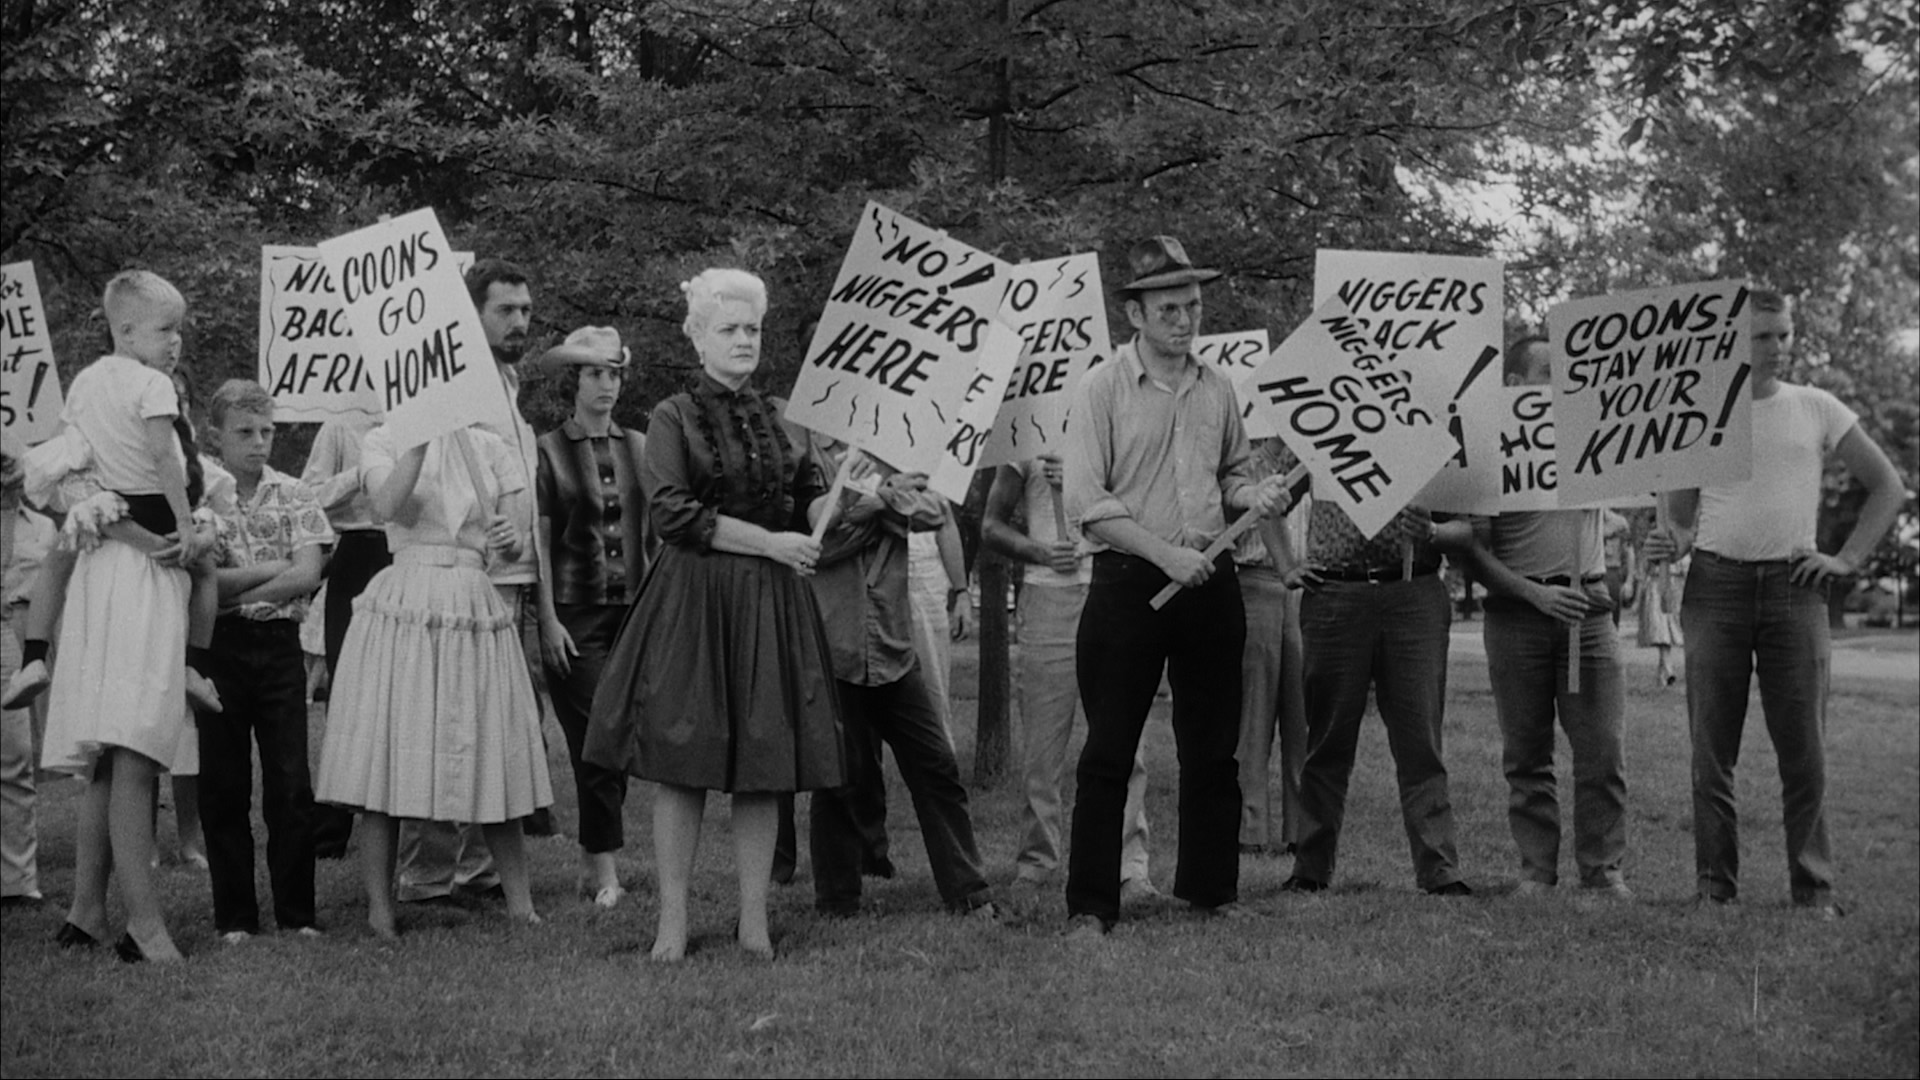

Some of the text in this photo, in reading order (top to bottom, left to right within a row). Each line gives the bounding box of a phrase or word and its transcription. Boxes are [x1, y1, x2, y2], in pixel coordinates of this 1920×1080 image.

[0, 273, 24, 299] or
[343, 230, 438, 304] COONS
[881, 235, 995, 296] NO!
[0, 305, 35, 339] LE
[281, 306, 353, 341] BAC
[379, 288, 425, 336] GO
[831, 274, 990, 352] NIGGERS
[1338, 278, 1487, 315] NIGGERS
[1565, 286, 1750, 358] COONS!
[813, 321, 940, 397] HERE
[1358, 318, 1457, 350] ACK
[1564, 329, 1738, 395] STAY WITH
[273, 352, 375, 397] AFRI
[385, 321, 466, 412] HOME
[1320, 316, 1433, 426] NIGGERS
[1600, 370, 1701, 421] YOUR
[1330, 375, 1386, 433] GO
[1574, 362, 1751, 476] KIND!
[1257, 376, 1392, 504] HOME
